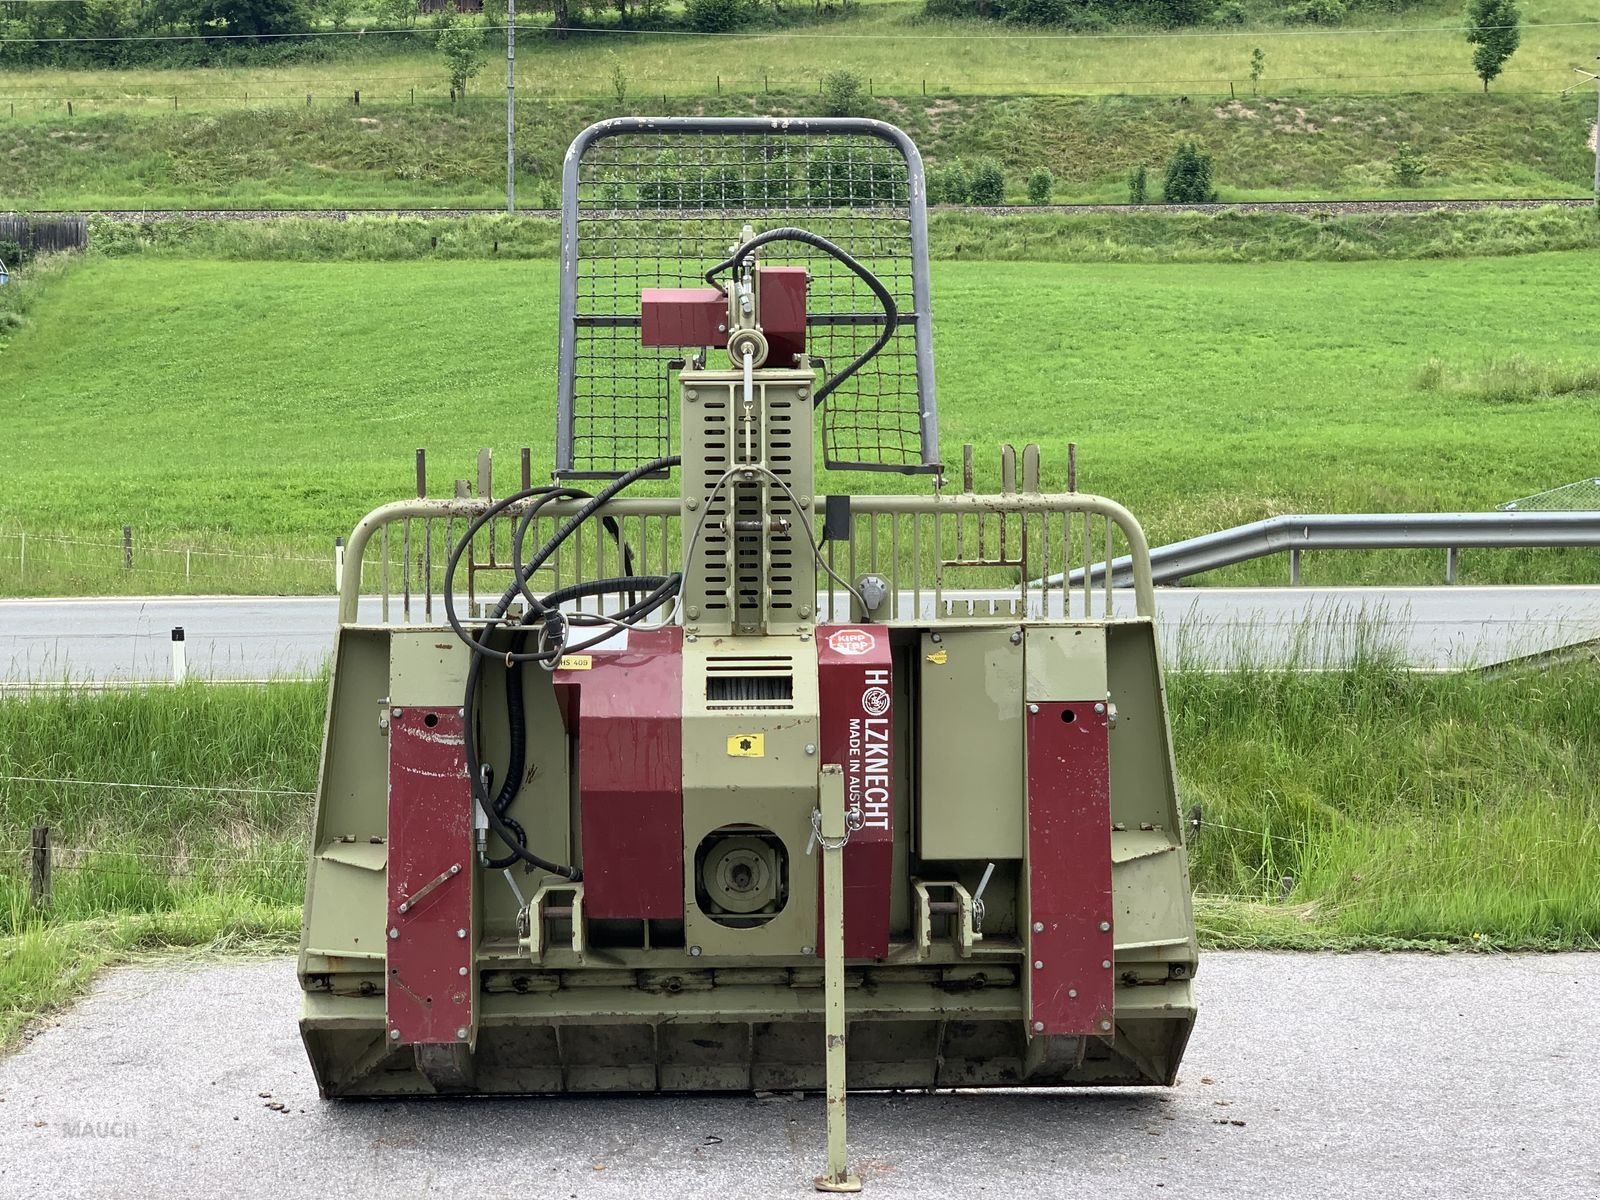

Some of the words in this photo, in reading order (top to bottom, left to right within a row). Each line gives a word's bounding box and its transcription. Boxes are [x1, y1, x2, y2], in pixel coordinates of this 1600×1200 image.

[849, 719, 861, 756] MADE
[862, 669, 891, 830] HOLZKNECHT
[848, 759, 861, 773] IN
[848, 776, 861, 827] AUST
